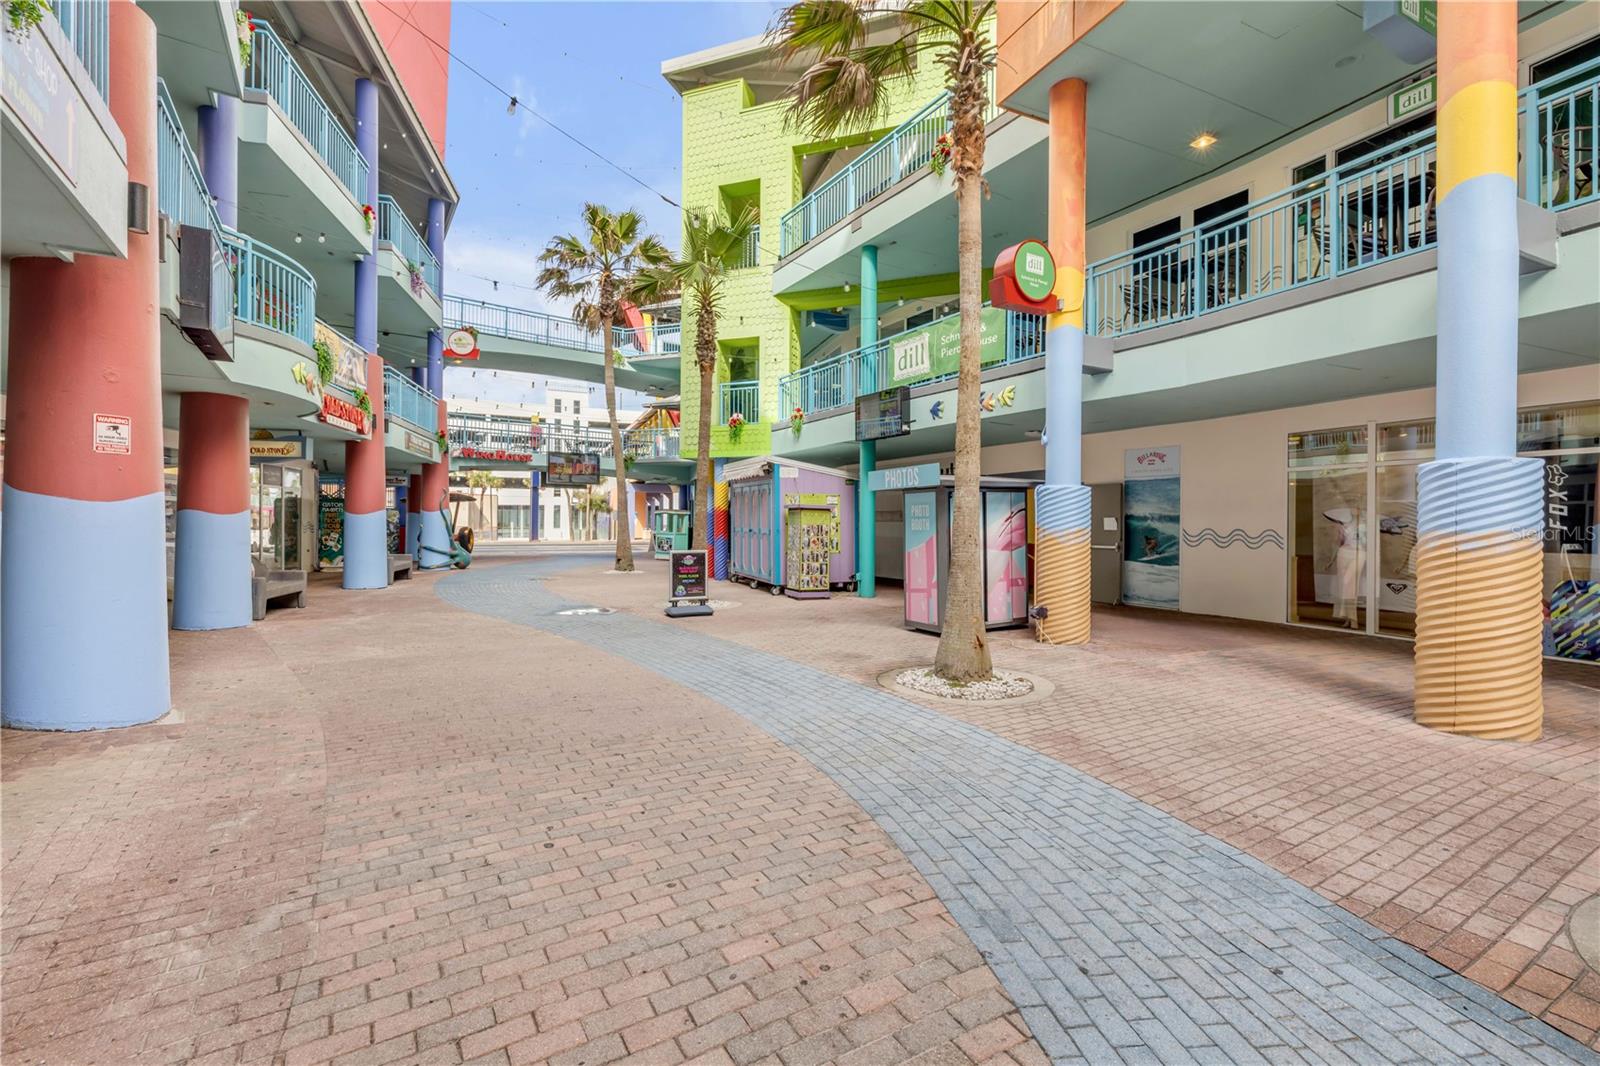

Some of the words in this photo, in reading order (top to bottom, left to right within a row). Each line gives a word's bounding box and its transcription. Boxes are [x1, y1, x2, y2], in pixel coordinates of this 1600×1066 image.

[1402, 87, 1427, 108] dill
[1027, 257, 1042, 272] dill
[898, 343, 925, 371] dill
[96, 415, 129, 425] WARNING
[884, 467, 919, 488] PHOTOS
[911, 504, 930, 517] PHOTO
[1548, 487, 1568, 531] FOX
[911, 518, 930, 531] BOOTH
